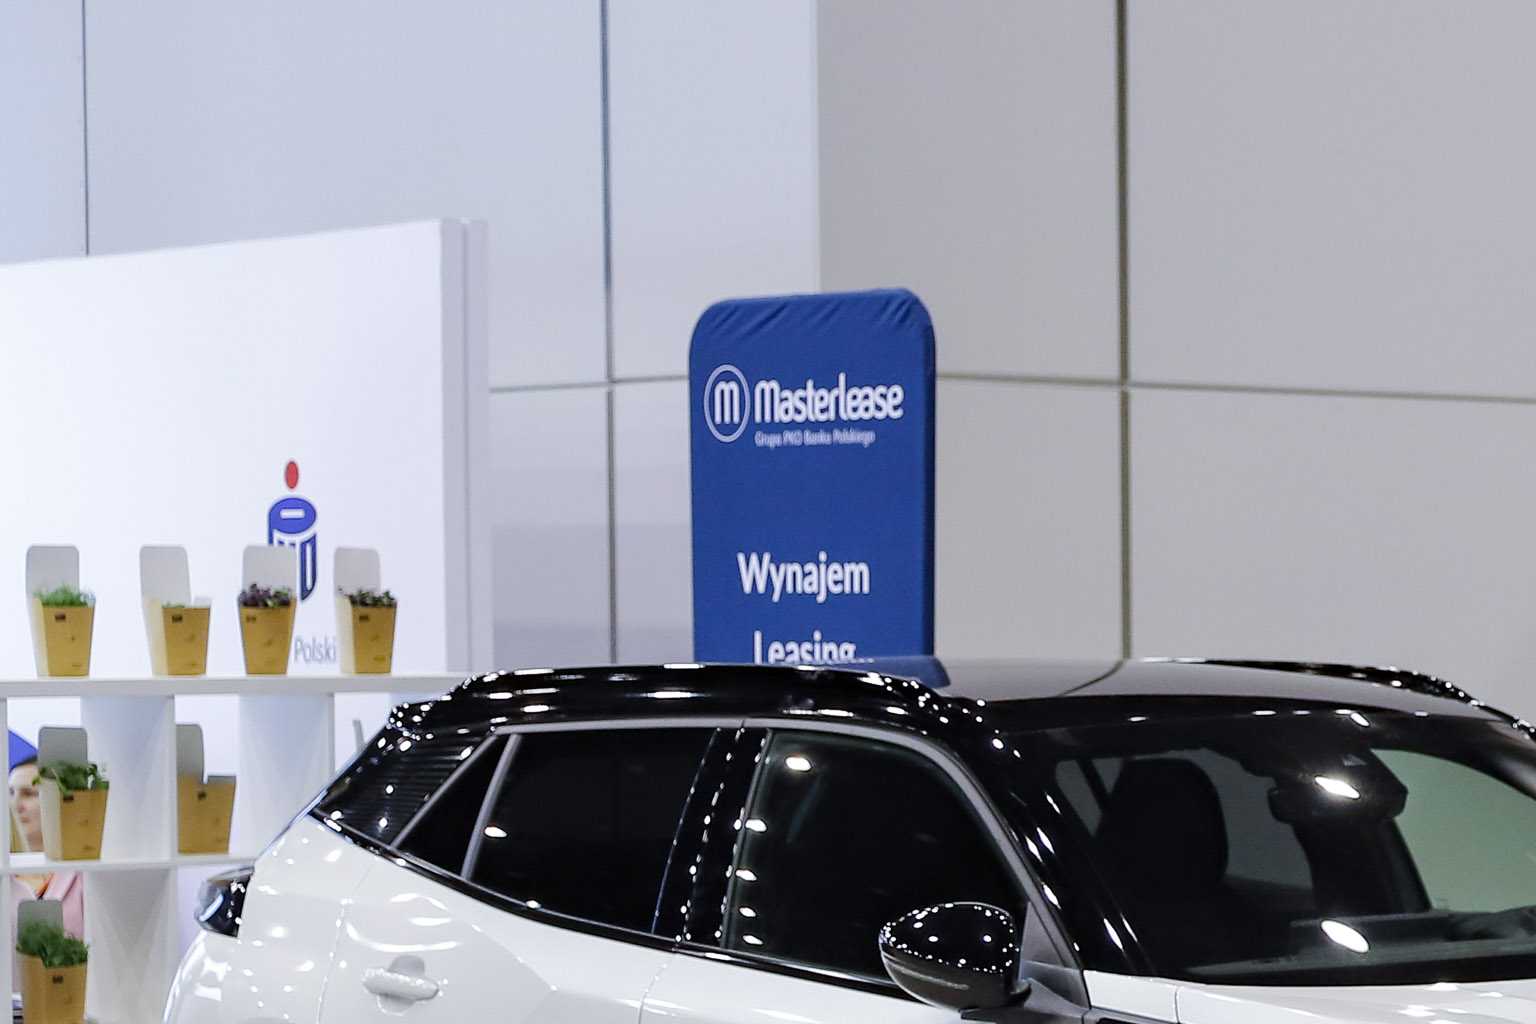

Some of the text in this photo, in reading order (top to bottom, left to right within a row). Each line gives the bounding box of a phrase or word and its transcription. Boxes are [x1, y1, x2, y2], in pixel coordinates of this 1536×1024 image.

[754, 372, 905, 424] Masterlease
[737, 551, 871, 603] Wynajem
[294, 636, 337, 664] Polski
